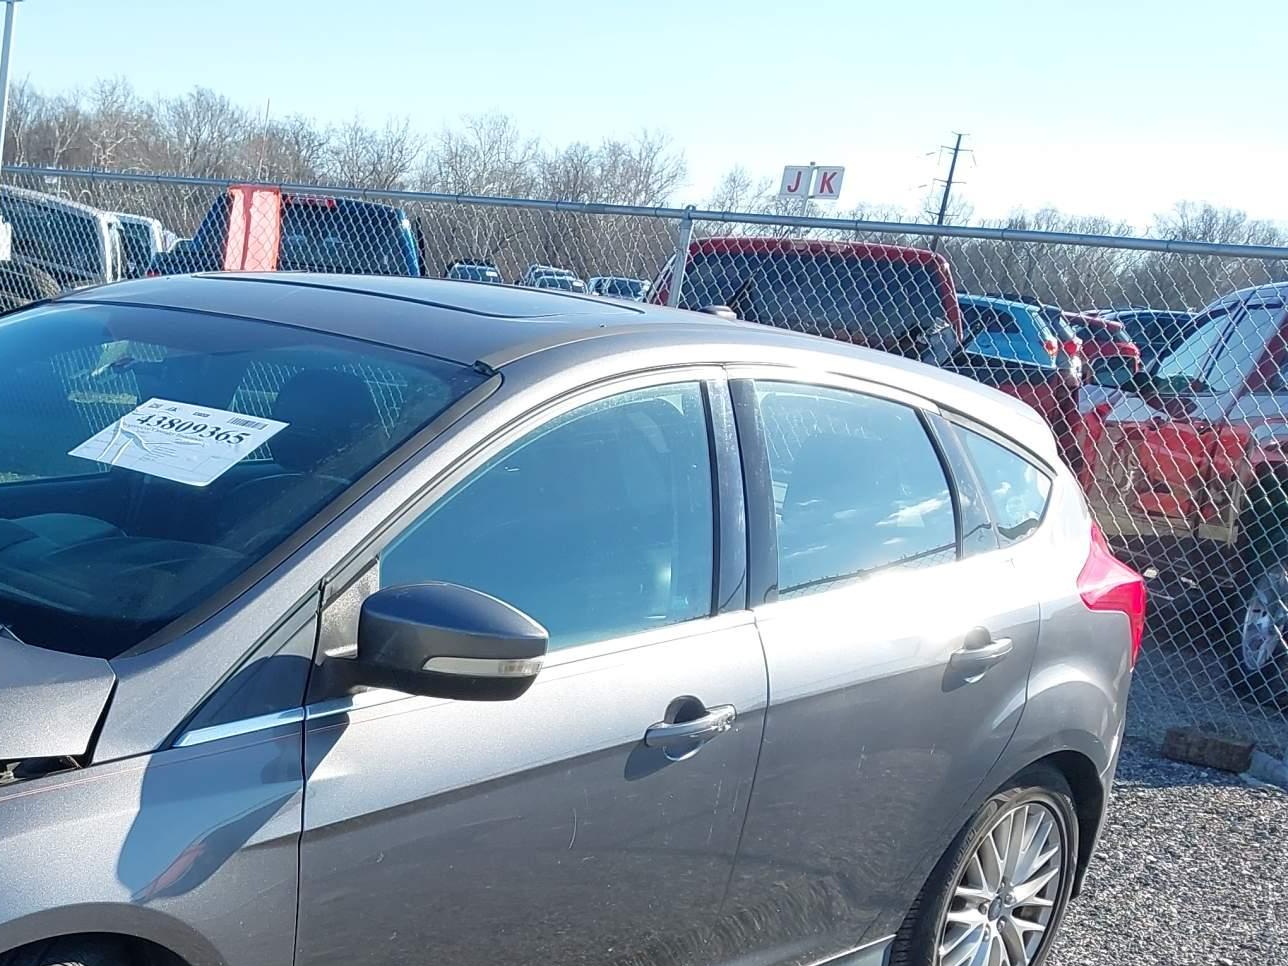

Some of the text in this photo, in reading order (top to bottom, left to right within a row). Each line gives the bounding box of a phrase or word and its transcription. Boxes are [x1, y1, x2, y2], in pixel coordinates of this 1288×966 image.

[787, 171, 802, 193] J
[819, 171, 838, 194] K
[136, 413, 251, 445] 43809365
